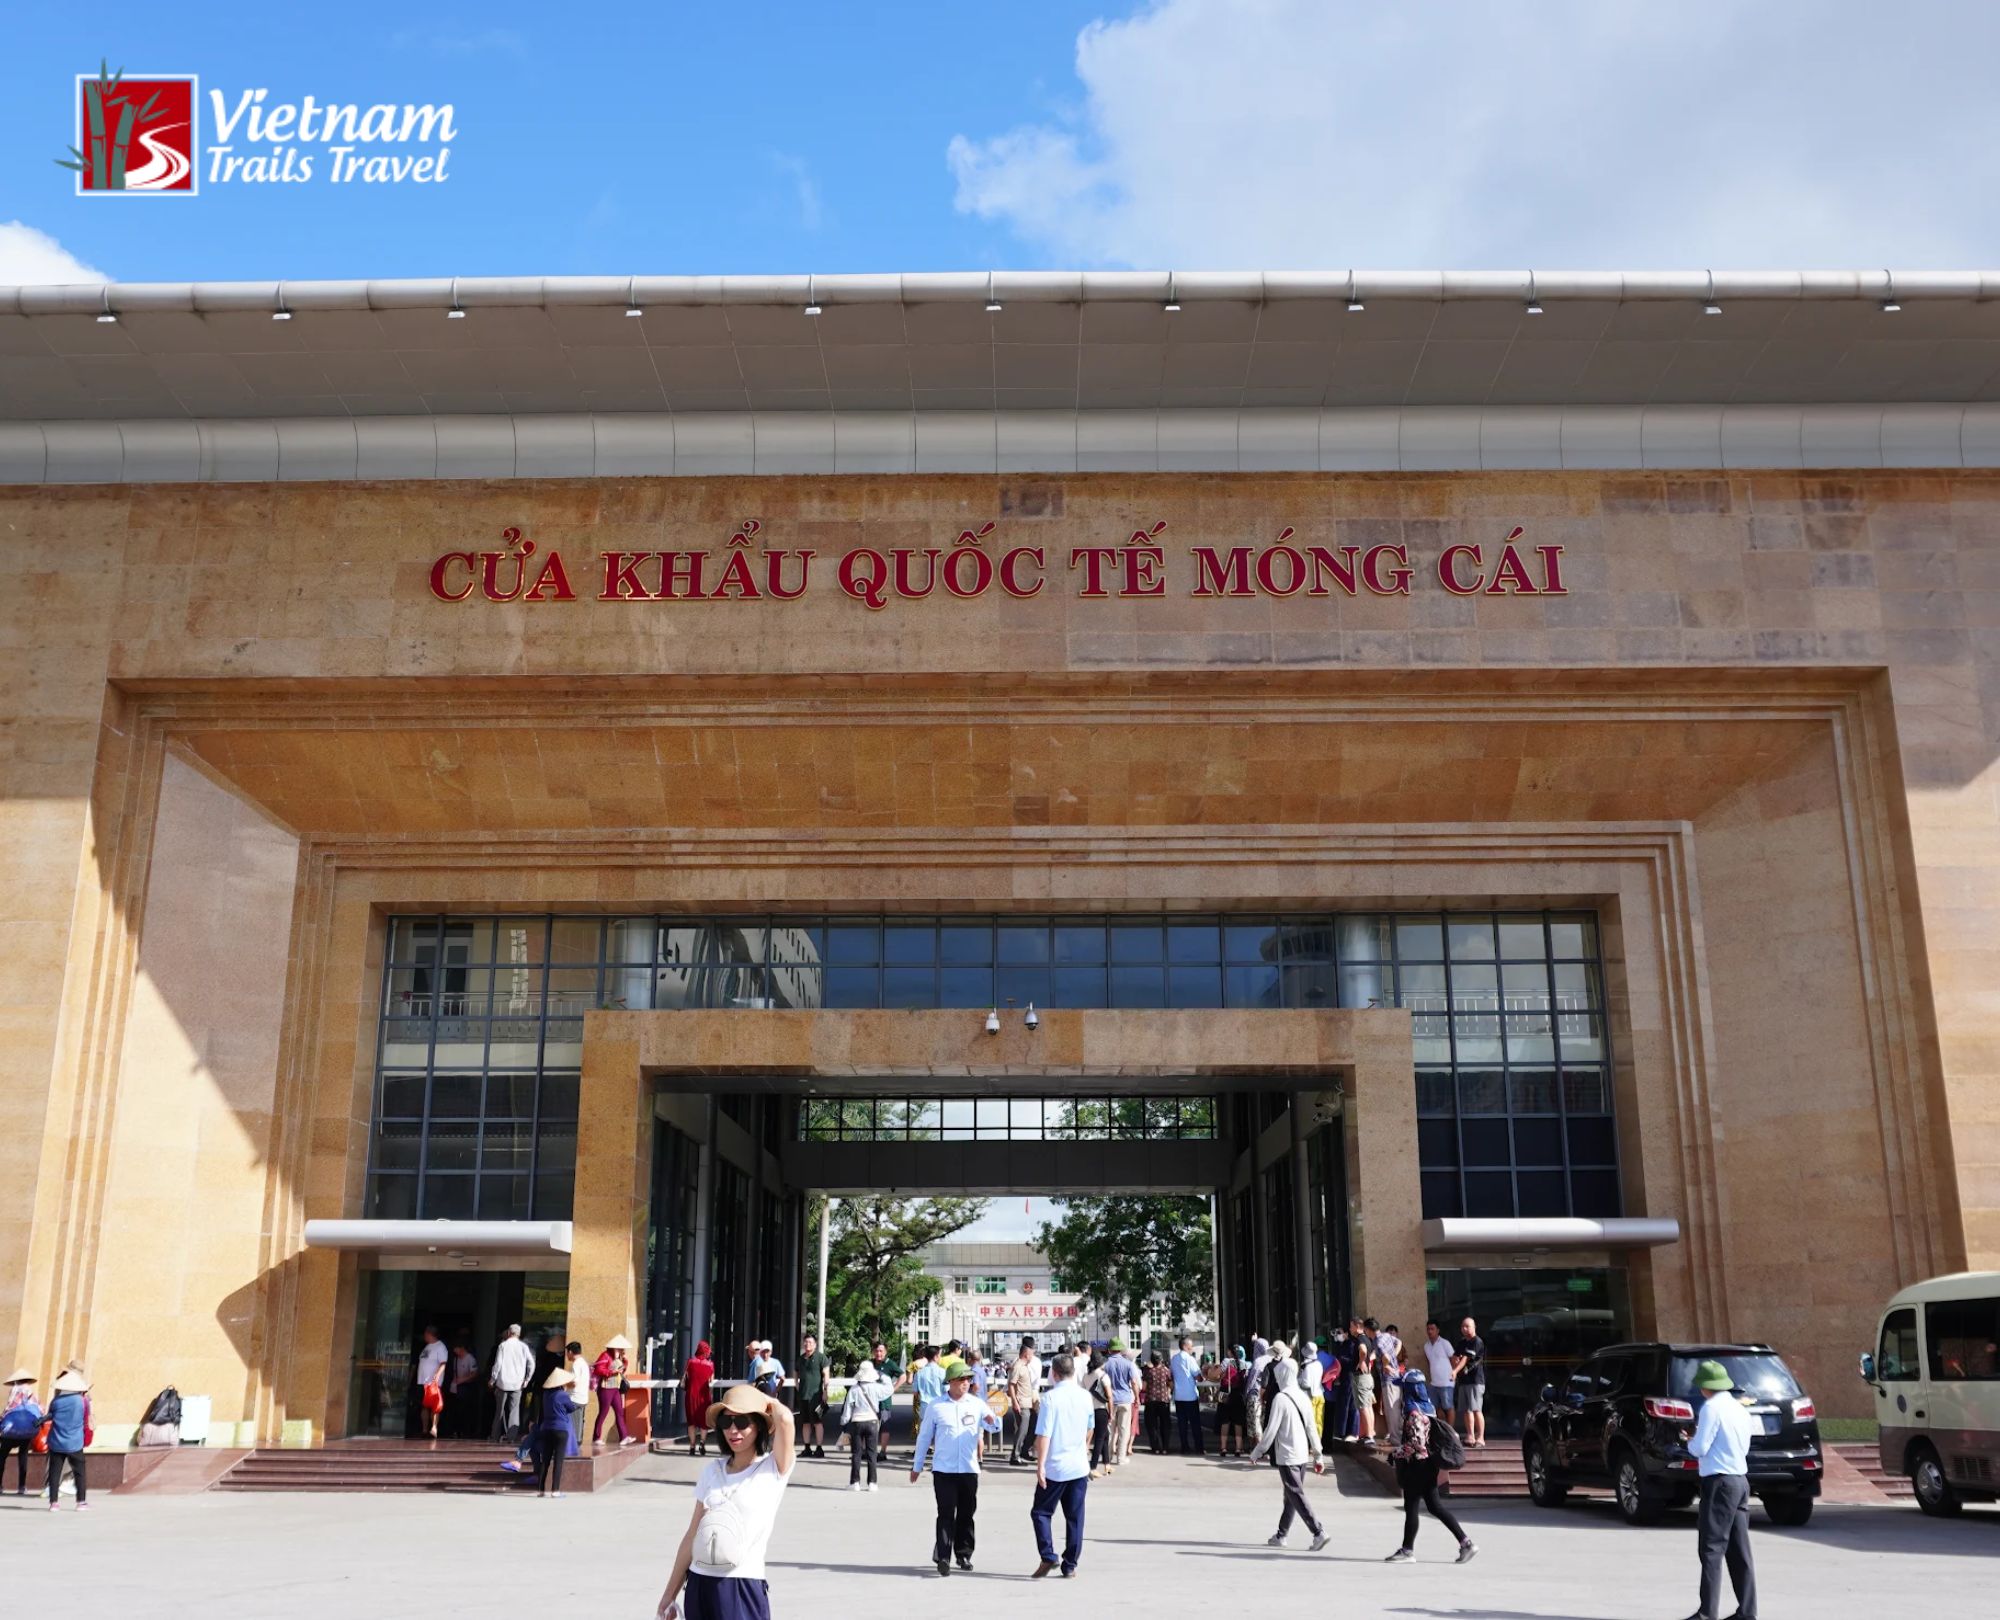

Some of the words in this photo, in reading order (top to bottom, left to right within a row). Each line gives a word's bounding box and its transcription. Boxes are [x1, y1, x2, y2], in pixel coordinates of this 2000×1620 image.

[429, 526, 577, 602] CỬA
[597, 519, 817, 601] KHẨU
[837, 520, 1046, 610] QUỐC
[1070, 520, 1168, 598] TẾ
[1190, 526, 1415, 597] MÓNG
[1437, 525, 1569, 596] CÁI
[979, 1305, 1079, 1318] 中华人民共和国
